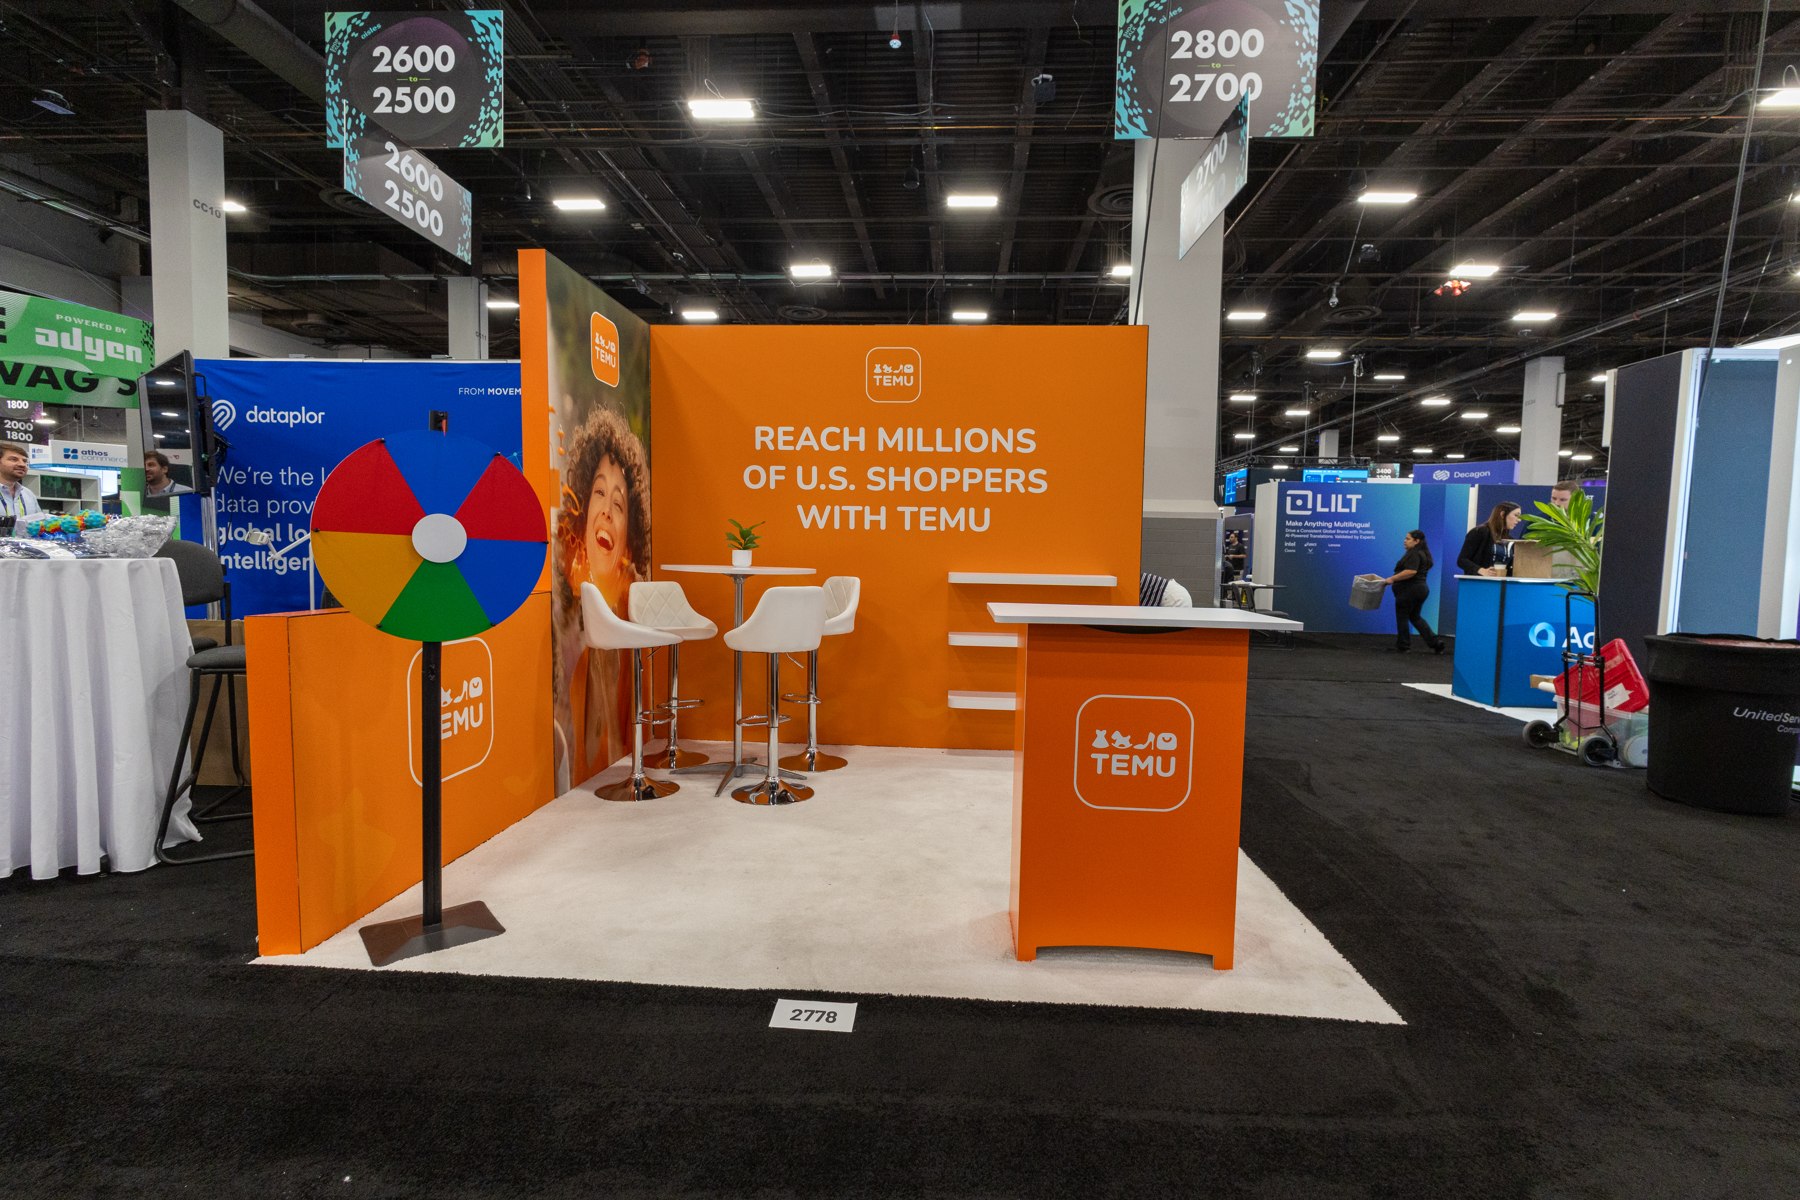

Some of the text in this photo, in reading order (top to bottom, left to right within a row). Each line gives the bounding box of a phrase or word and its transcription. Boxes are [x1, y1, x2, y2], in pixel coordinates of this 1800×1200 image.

[1159, 6, 1183, 24] ailes
[361, 23, 381, 39] aisles
[1170, 28, 1265, 59] 2800
[372, 45, 455, 73] 2600
[1169, 72, 1263, 102] 2700
[372, 86, 456, 114] 2500
[384, 141, 444, 202] 2600
[193, 199, 221, 218] CC10
[384, 179, 444, 237] 2500
[55, 313, 128, 334] POWERED BY
[35, 327, 143, 364] adyen
[594, 346, 616, 368] TEMU
[458, 387, 485, 396] FROM
[873, 375, 914, 387] TEMU
[6, 400, 29, 409] 1800
[4, 420, 33, 431] 2000
[245, 405, 325, 428] dataplor
[6, 431, 33, 442] 1800
[755, 426, 1037, 453] REACH MILLIONS
[279, 466, 314, 486] the
[743, 465, 1048, 493] OF U.S. SHOPPERS
[217, 493, 259, 513] data
[1317, 494, 1362, 512] LILT
[797, 504, 991, 532] WITH TEMU
[1334, 521, 1370, 529] Multilingual
[441, 702, 483, 740] EMU
[1090, 753, 1176, 777] TEMU
[789, 1009, 838, 1024] 2778
